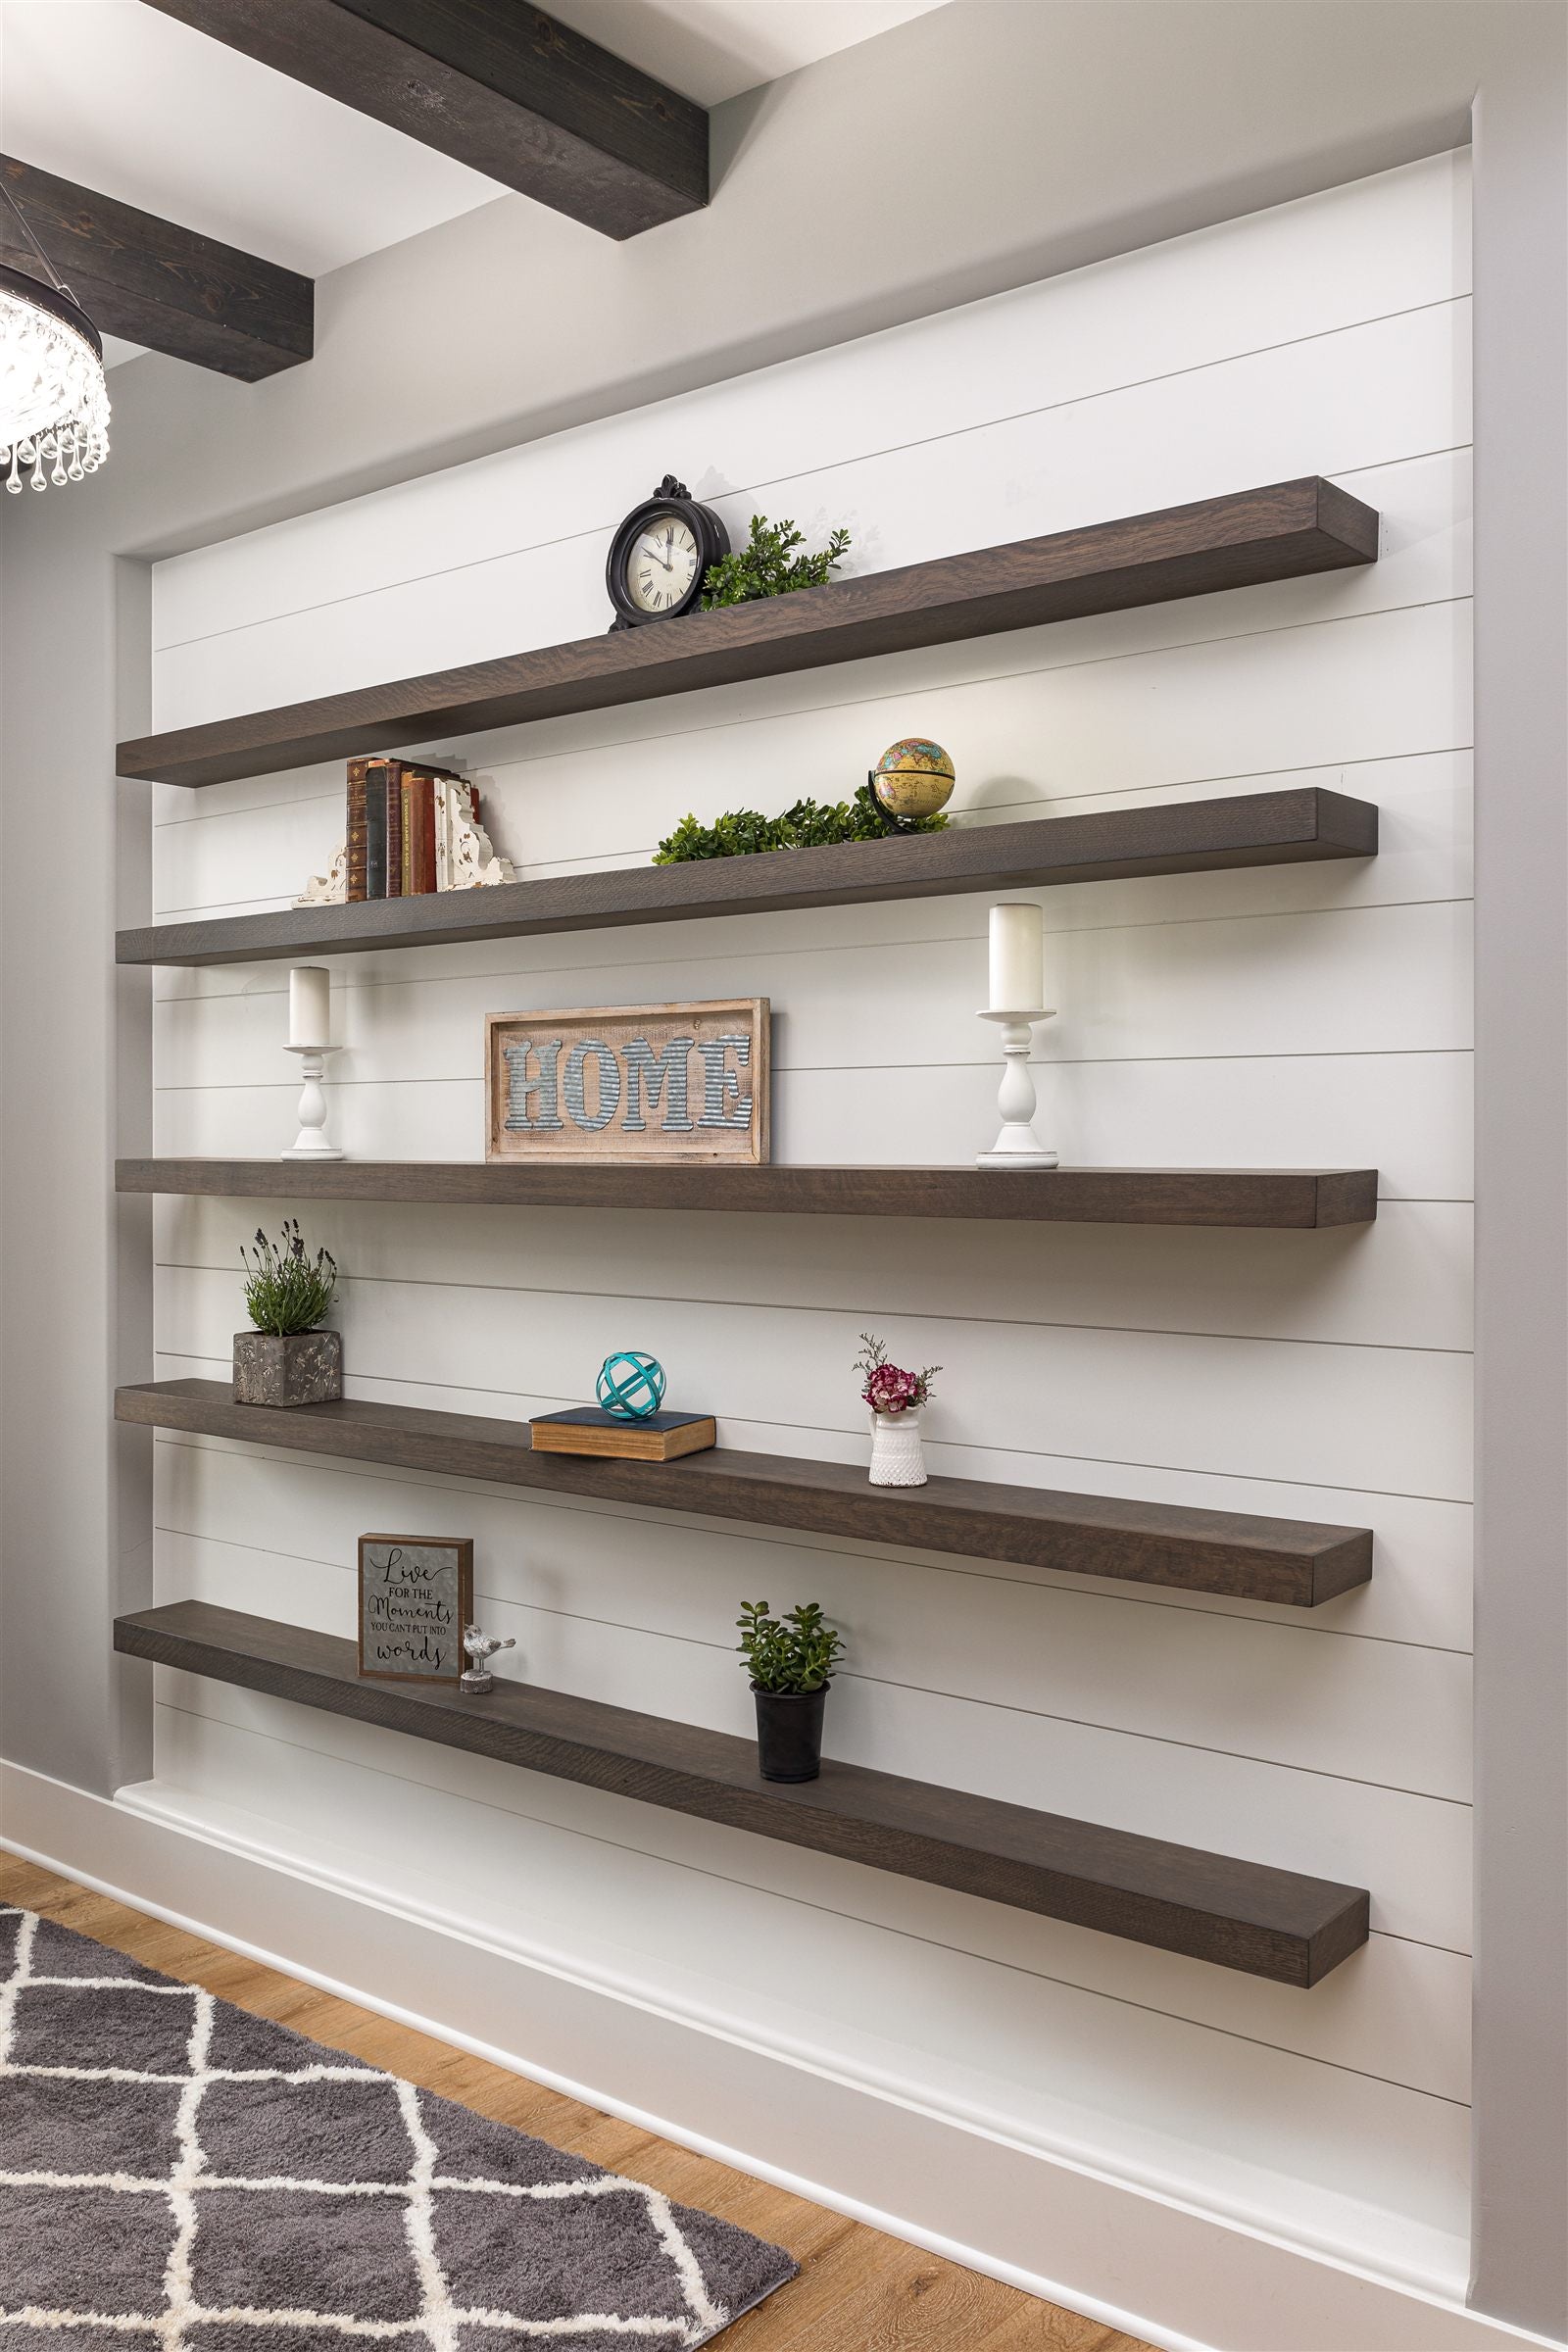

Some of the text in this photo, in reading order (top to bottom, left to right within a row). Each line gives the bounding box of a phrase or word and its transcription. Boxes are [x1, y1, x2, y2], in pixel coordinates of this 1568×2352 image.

[503, 1034, 753, 1132] HOME
[369, 1547, 453, 1584] Live
[368, 1594, 453, 1624] Moments
[389, 1587, 433, 1599] FOR THE
[370, 1622, 388, 1631] YOU
[413, 1624, 427, 1635] PUT
[429, 1626, 446, 1636] INTO
[376, 1636, 447, 1670] words
